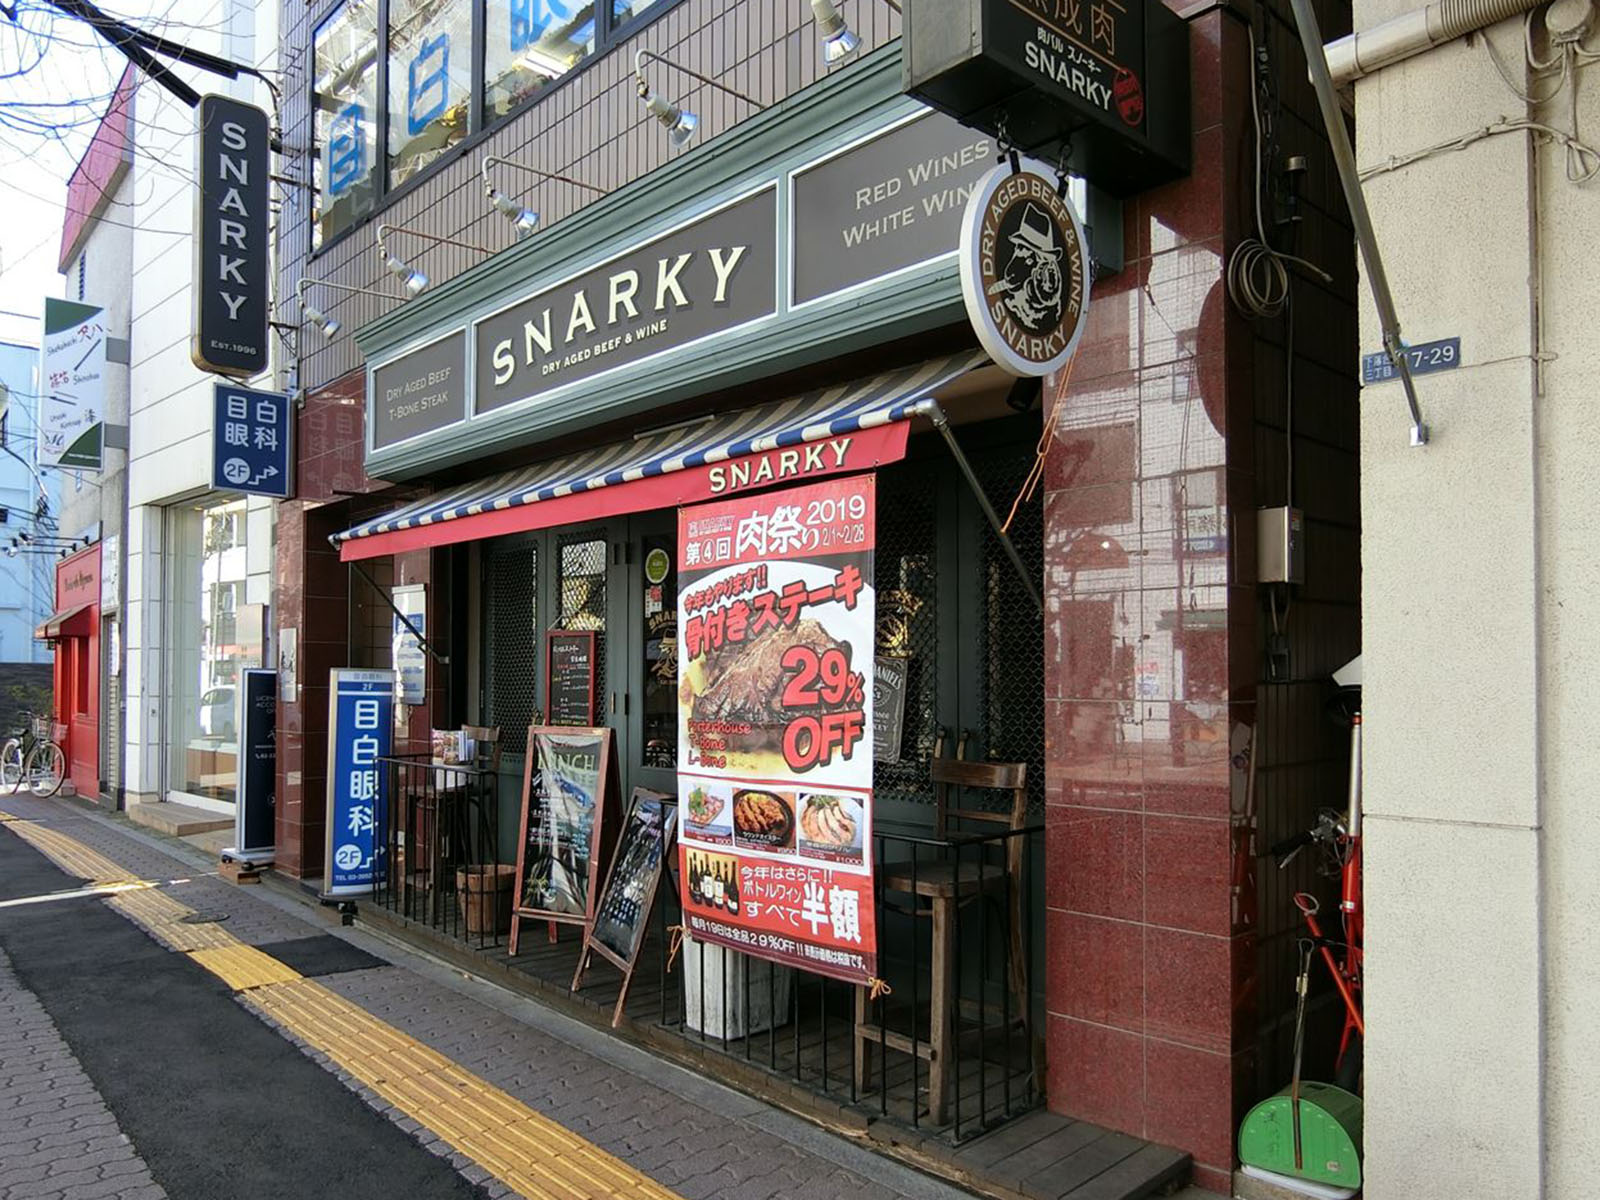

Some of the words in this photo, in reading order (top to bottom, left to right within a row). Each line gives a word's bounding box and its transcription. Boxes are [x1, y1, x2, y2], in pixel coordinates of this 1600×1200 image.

[1029, 0, 1115, 56] 成肉
[1037, 26, 1064, 53] 肉バル
[1067, 45, 1102, 73] スノーキー
[1025, 41, 1113, 110] SNARKY
[855, 177, 901, 210] RED
[908, 139, 990, 188] WINES
[992, 178, 1028, 223] AGED
[1031, 179, 1070, 224] BEEF
[218, 121, 249, 321] SNARKY
[843, 206, 915, 249] WHITE
[1065, 228, 1075, 247] &
[982, 221, 996, 277] DRY
[1069, 250, 1084, 319] WINE
[493, 246, 747, 386] SNARKY
[992, 301, 1066, 361] SNARKY
[542, 359, 561, 375] DRY
[564, 349, 591, 367] AGED
[594, 336, 621, 356] BEEF
[624, 332, 633, 345] &
[635, 319, 667, 340] WINE
[1411, 346, 1454, 368] 7-29
[404, 377, 427, 396] AGED
[428, 367, 451, 386] BEEF
[421, 391, 449, 410] STEAK
[225, 422, 278, 451] 眼科
[227, 395, 277, 424] 目白
[226, 463, 248, 478] 2F
[709, 438, 852, 493] SNARKY
[735, 505, 820, 560] 肉祭り
[806, 494, 866, 525] 2019
[685, 564, 863, 661] 骨付きステーキ
[780, 645, 866, 711] 29%
[348, 699, 379, 837] 目白眼科
[783, 710, 866, 774] OFF
[338, 850, 359, 865] 2F
[740, 865, 833, 884] 今年はさらに!!
[743, 901, 799, 927] すべて
[802, 882, 861, 944] 半額
